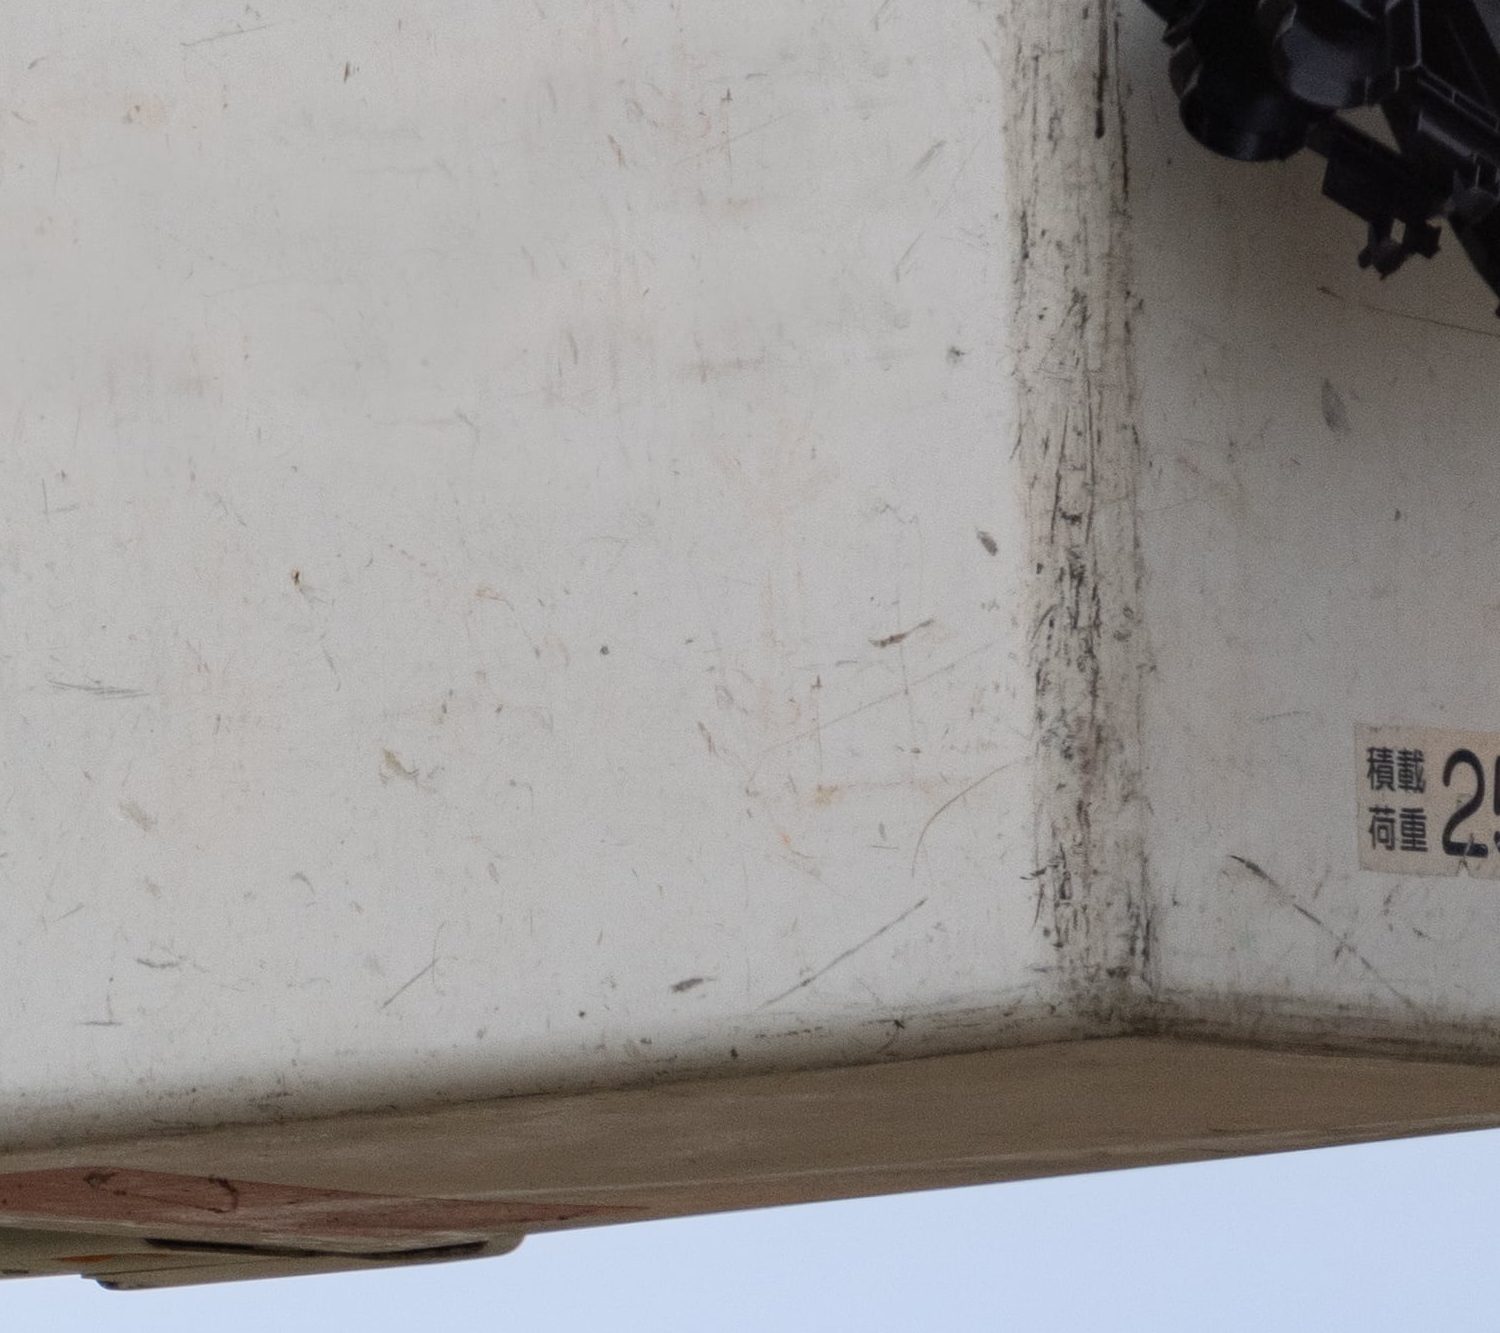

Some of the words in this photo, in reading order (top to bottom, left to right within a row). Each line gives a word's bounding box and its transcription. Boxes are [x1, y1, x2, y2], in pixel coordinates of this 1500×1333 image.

[1366, 746, 1426, 794] 積載
[1442, 748, 1500, 859] 2
[1368, 805, 1428, 852] 荷重
